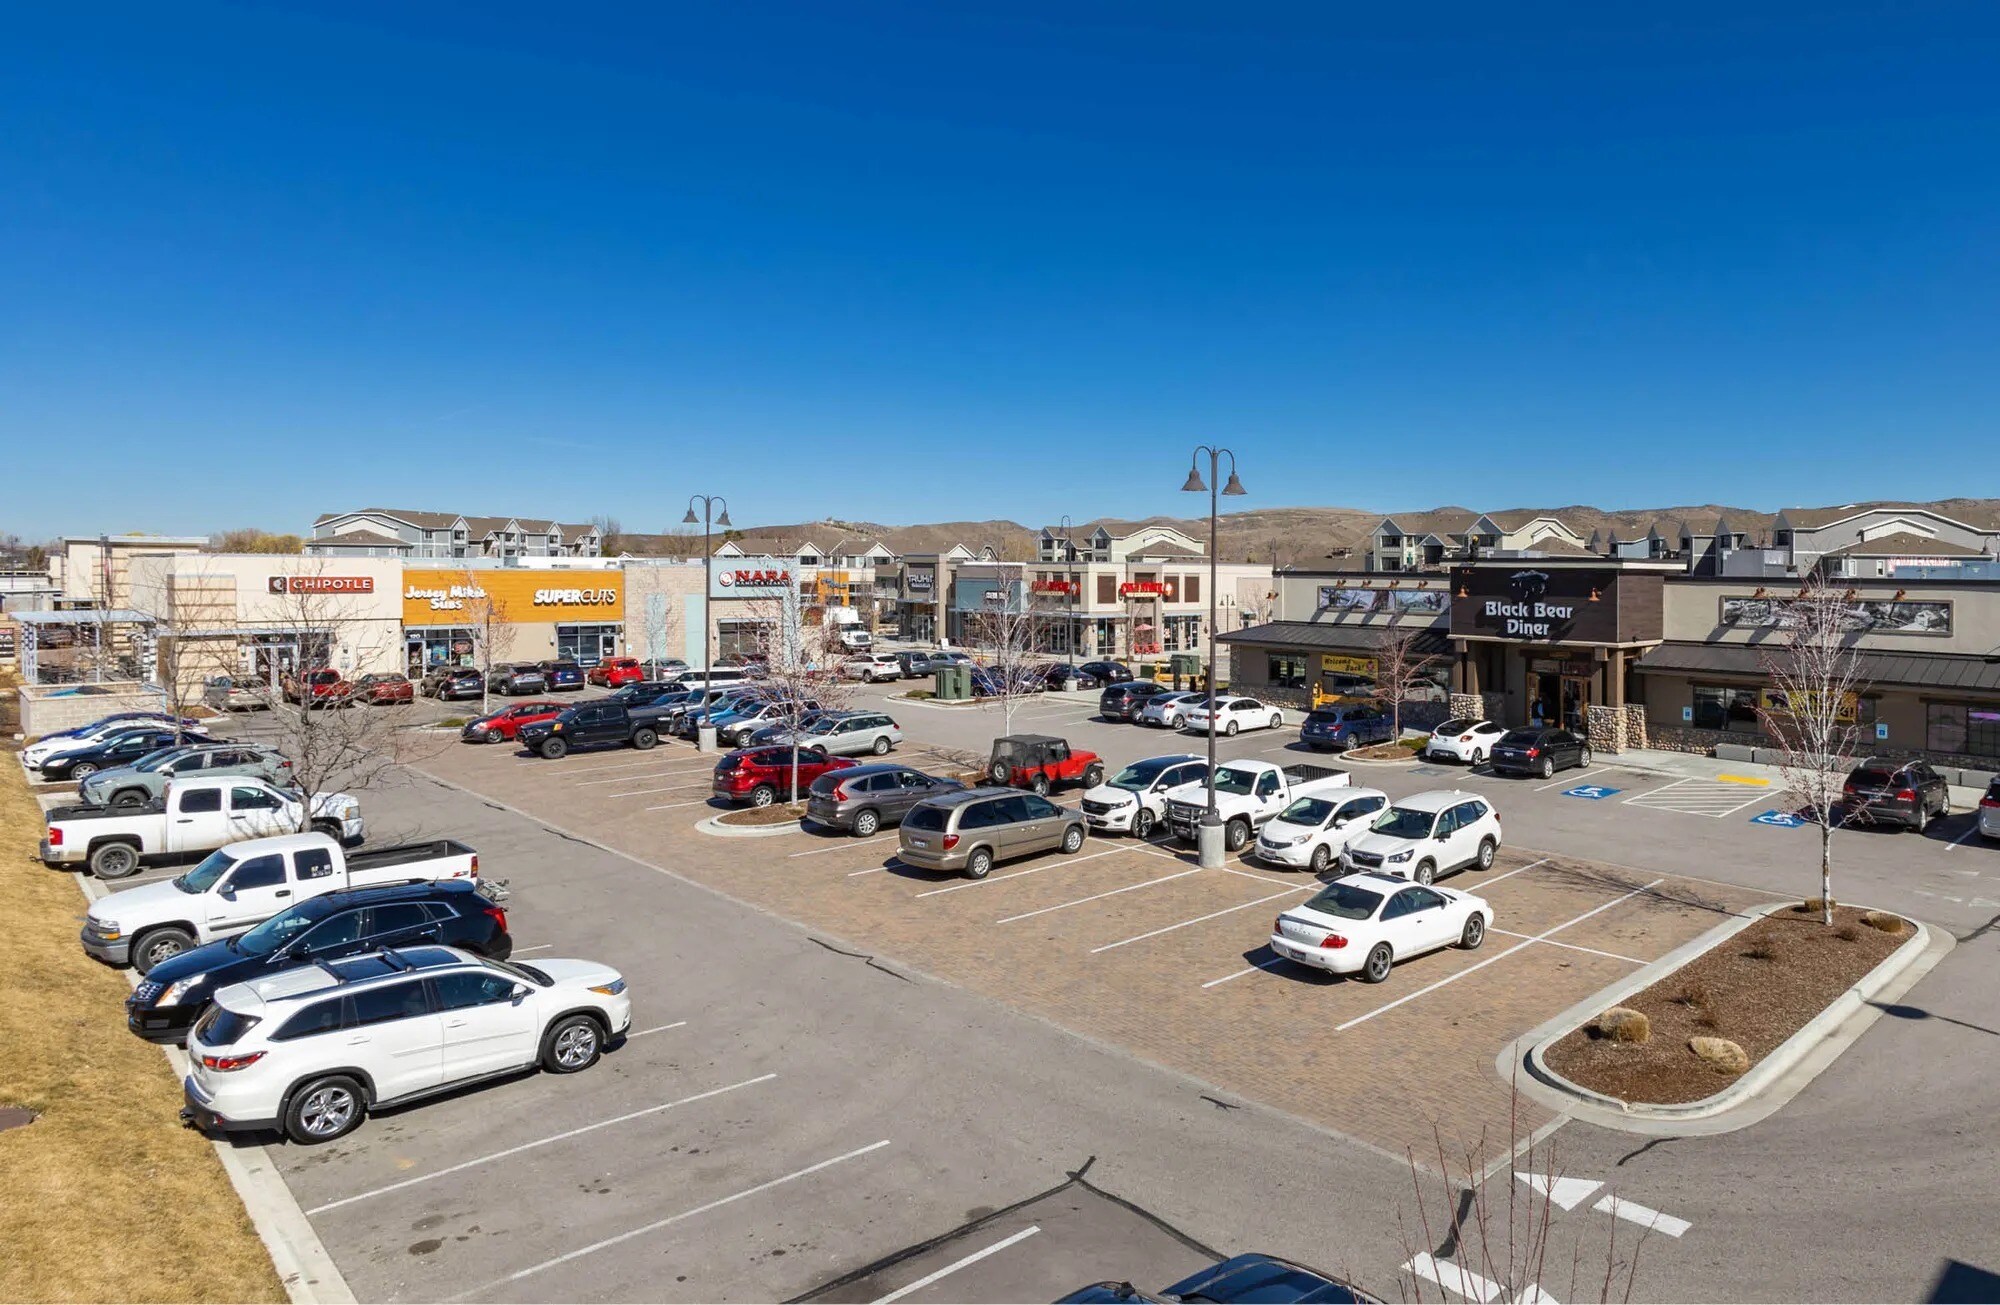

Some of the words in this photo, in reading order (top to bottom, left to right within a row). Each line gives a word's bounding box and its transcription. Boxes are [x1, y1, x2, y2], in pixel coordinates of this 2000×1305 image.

[735, 570, 792, 582] NARA
[293, 579, 371, 589] CHIPOTLE
[404, 585, 447, 600] Jersey
[534, 588, 616, 604] SUPERCUTS
[1485, 601, 1529, 617] Black
[1534, 602, 1573, 618] Bear
[1507, 619, 1549, 635] Diner
